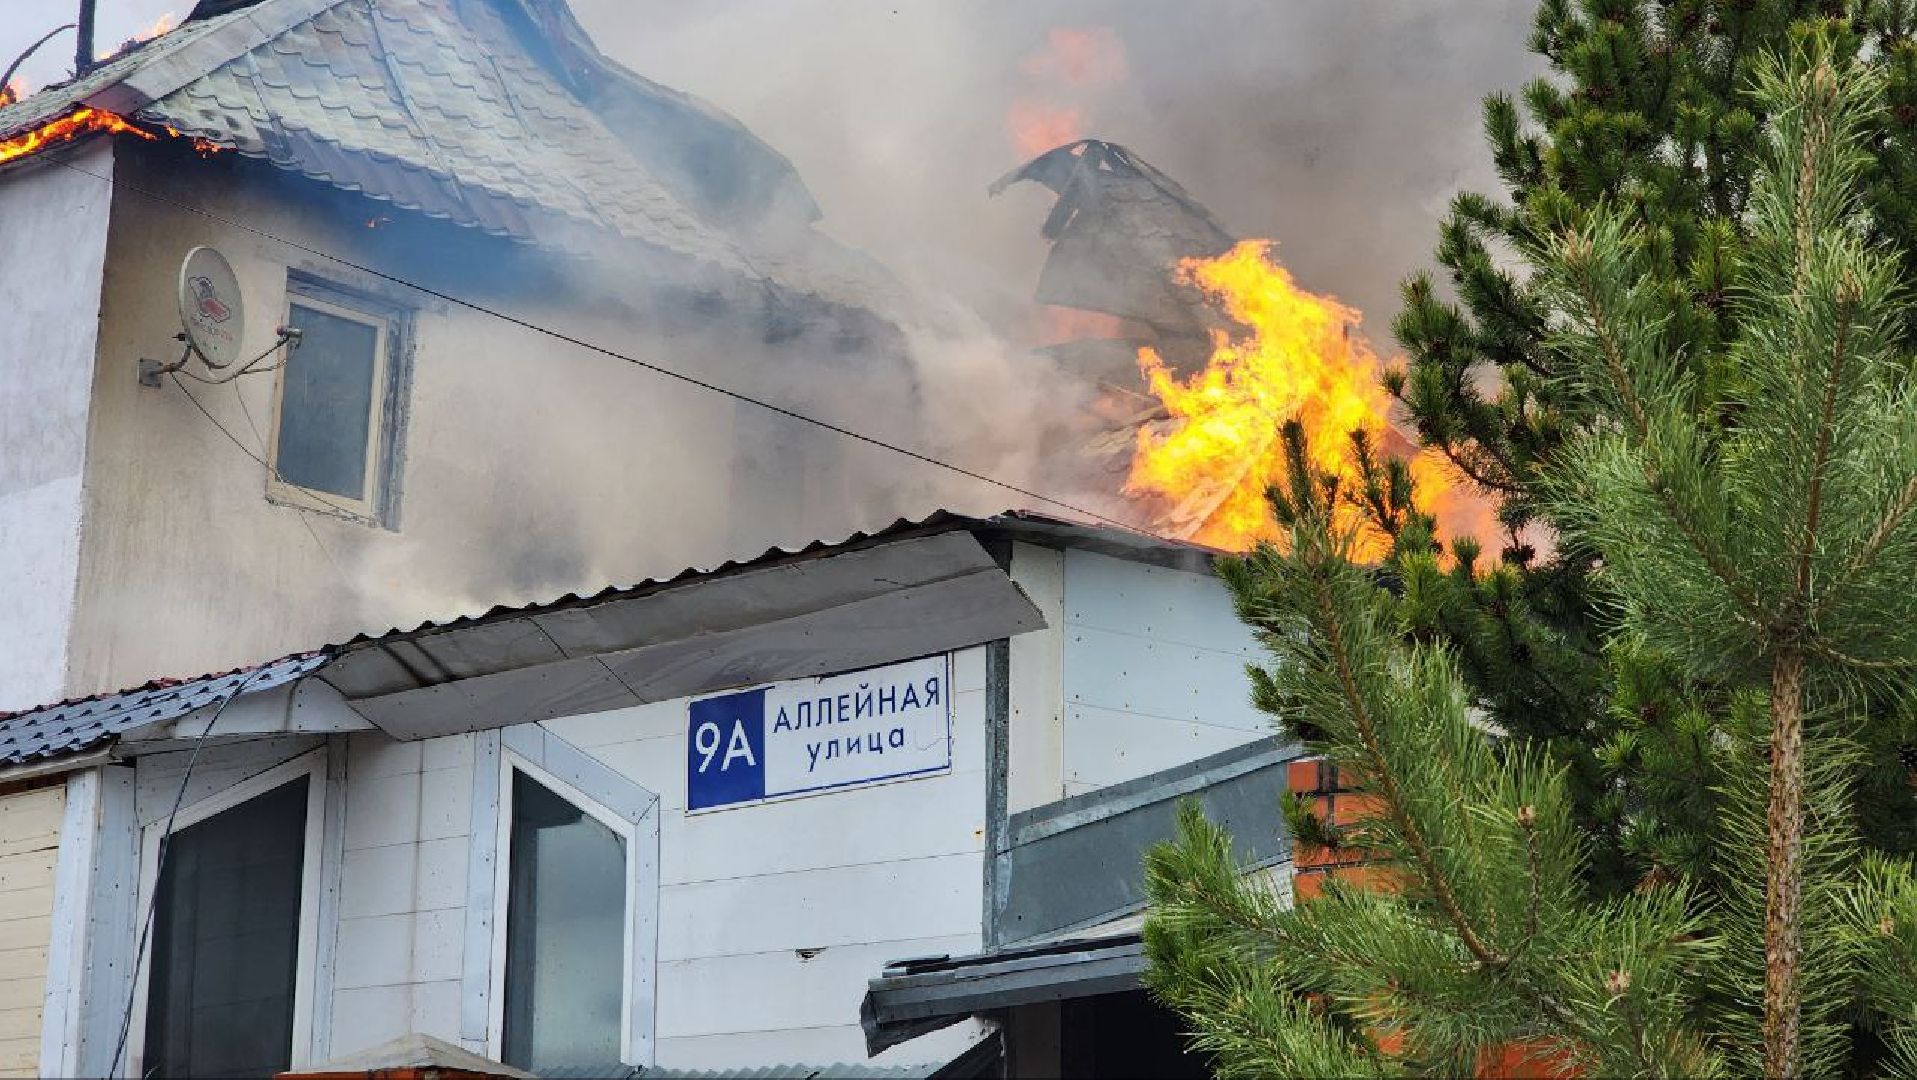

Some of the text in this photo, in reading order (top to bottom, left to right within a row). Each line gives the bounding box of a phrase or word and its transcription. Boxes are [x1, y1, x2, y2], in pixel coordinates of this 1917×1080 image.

[773, 677, 940, 734] АЛЛЕЙНАЯ
[694, 718, 757, 773] 9А
[807, 728, 904, 773] улица
